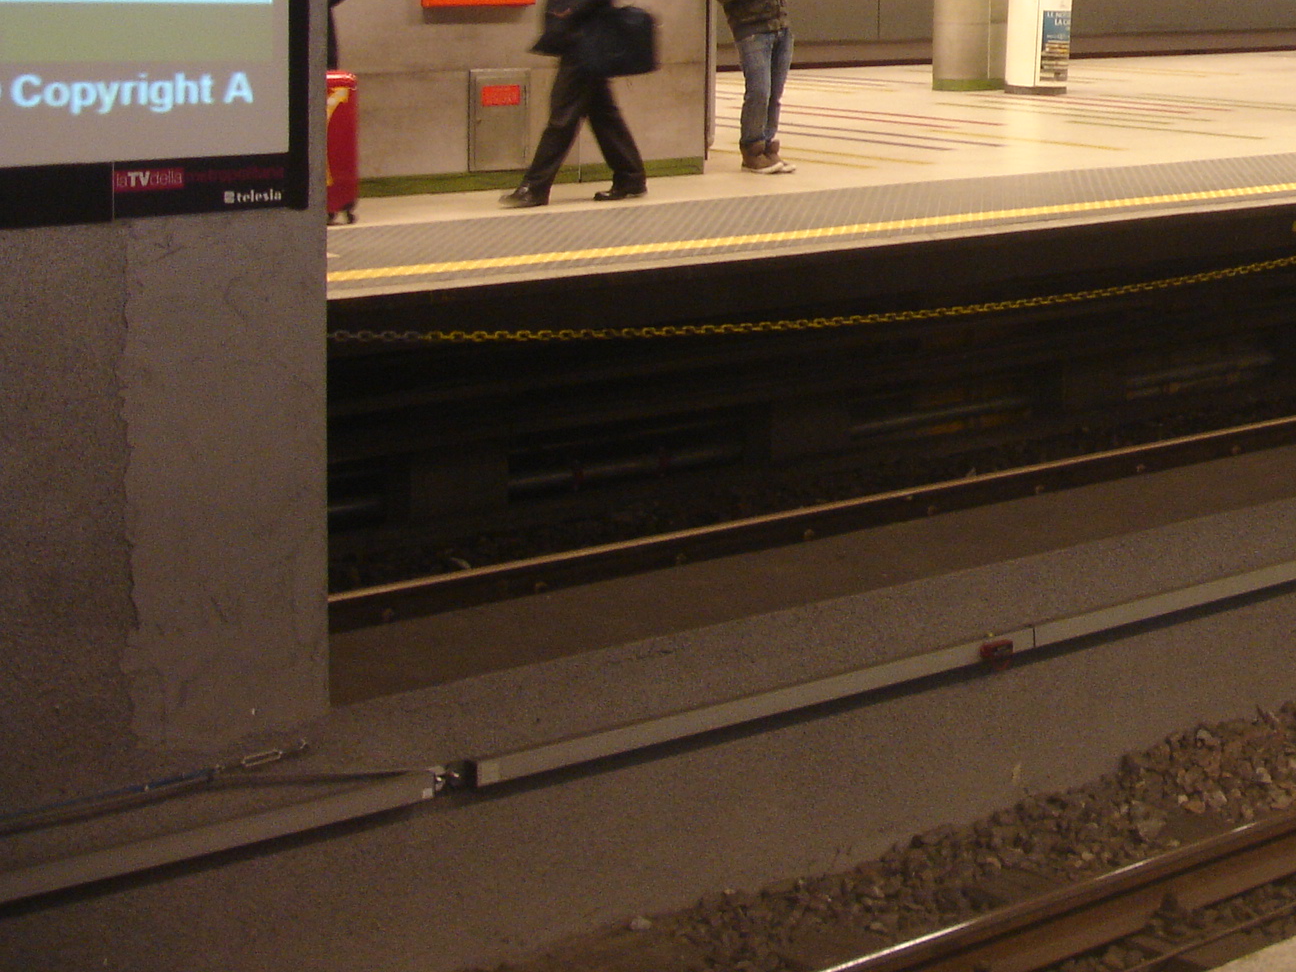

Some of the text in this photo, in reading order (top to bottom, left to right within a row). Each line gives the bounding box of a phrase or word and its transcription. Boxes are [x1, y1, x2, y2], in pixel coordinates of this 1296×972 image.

[11, 71, 254, 115] Copyright A
[236, 188, 282, 203] telesia
